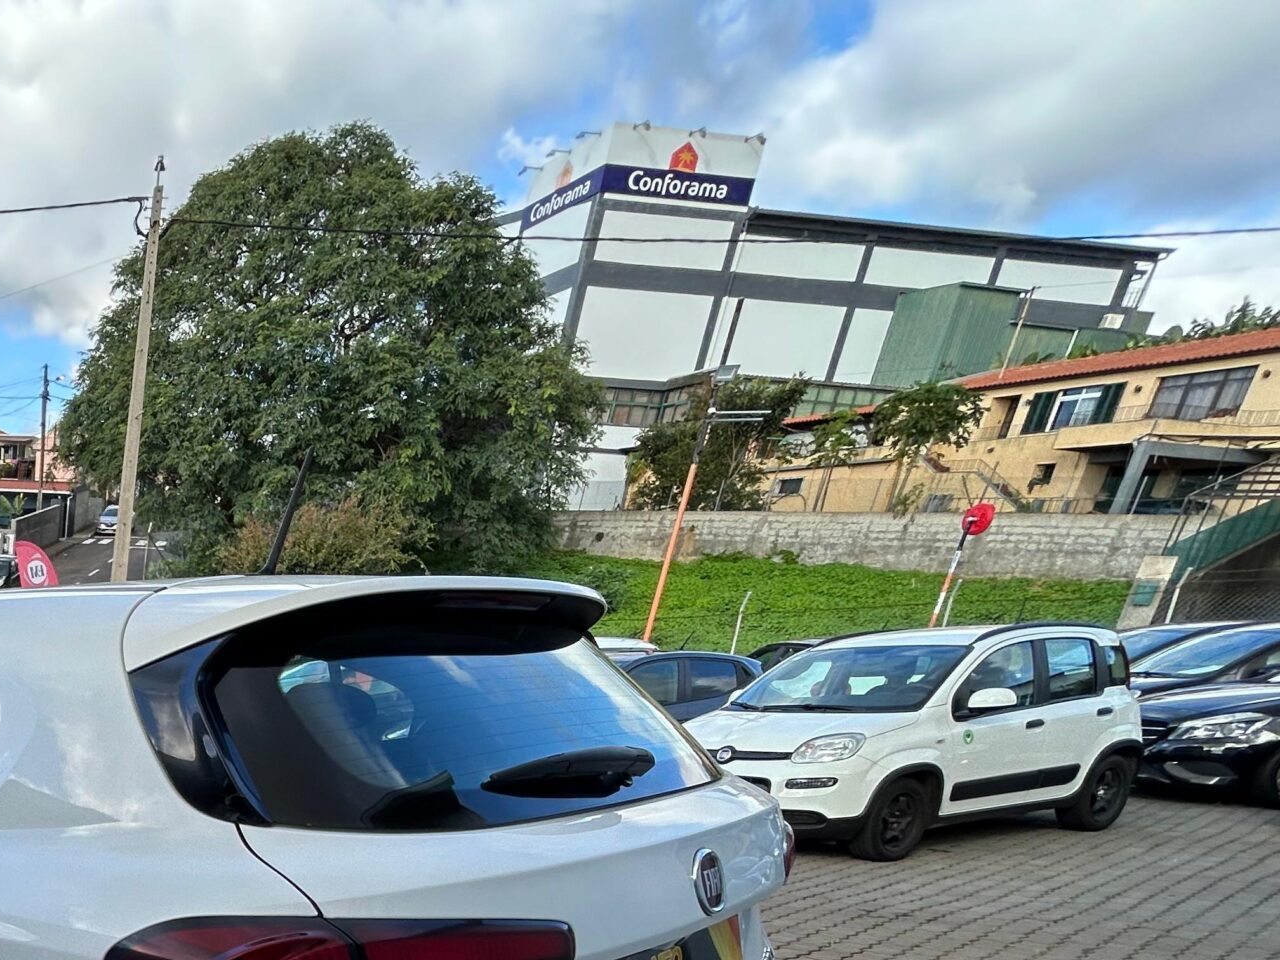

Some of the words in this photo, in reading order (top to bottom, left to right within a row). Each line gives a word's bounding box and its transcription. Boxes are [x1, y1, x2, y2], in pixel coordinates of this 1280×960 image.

[628, 170, 728, 199] Conforama
[530, 180, 591, 222] Conforama
[703, 867, 722, 898] FIA
